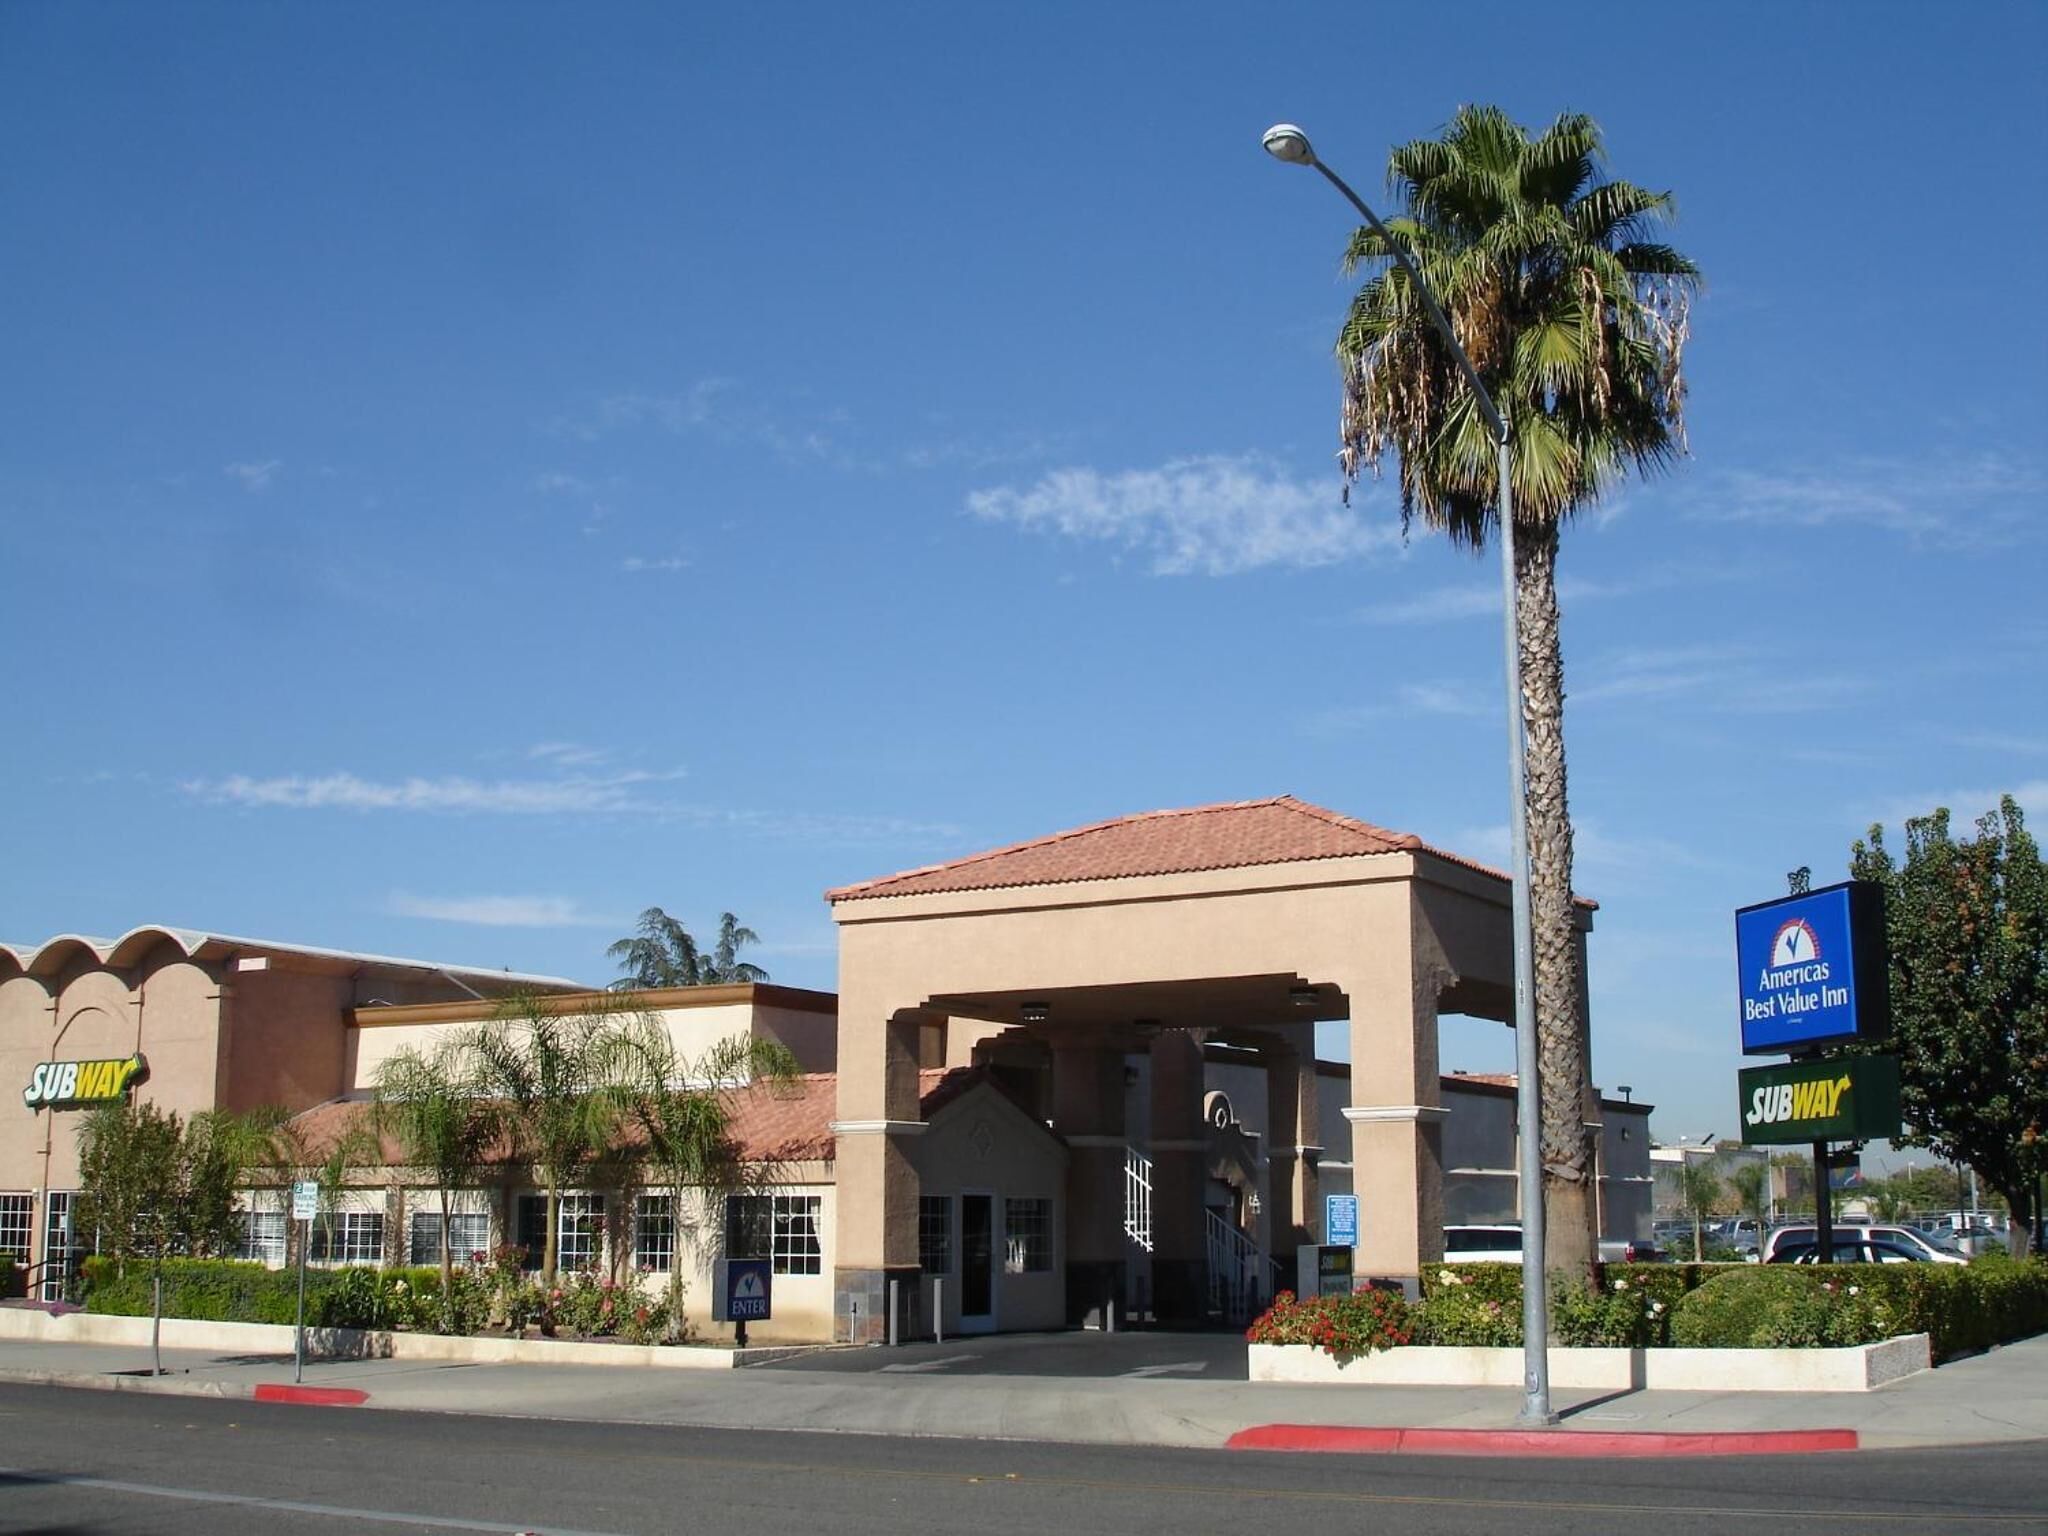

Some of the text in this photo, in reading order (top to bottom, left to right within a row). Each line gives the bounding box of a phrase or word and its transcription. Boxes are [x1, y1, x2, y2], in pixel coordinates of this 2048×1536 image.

[1759, 962, 1829, 990] Americas
[1745, 985, 1848, 1021] Best Value Inn
[24, 1060, 138, 1101] SUBWAY
[1746, 1074, 1851, 1126] SUBWAY
[732, 1300, 766, 1315] ENTER
